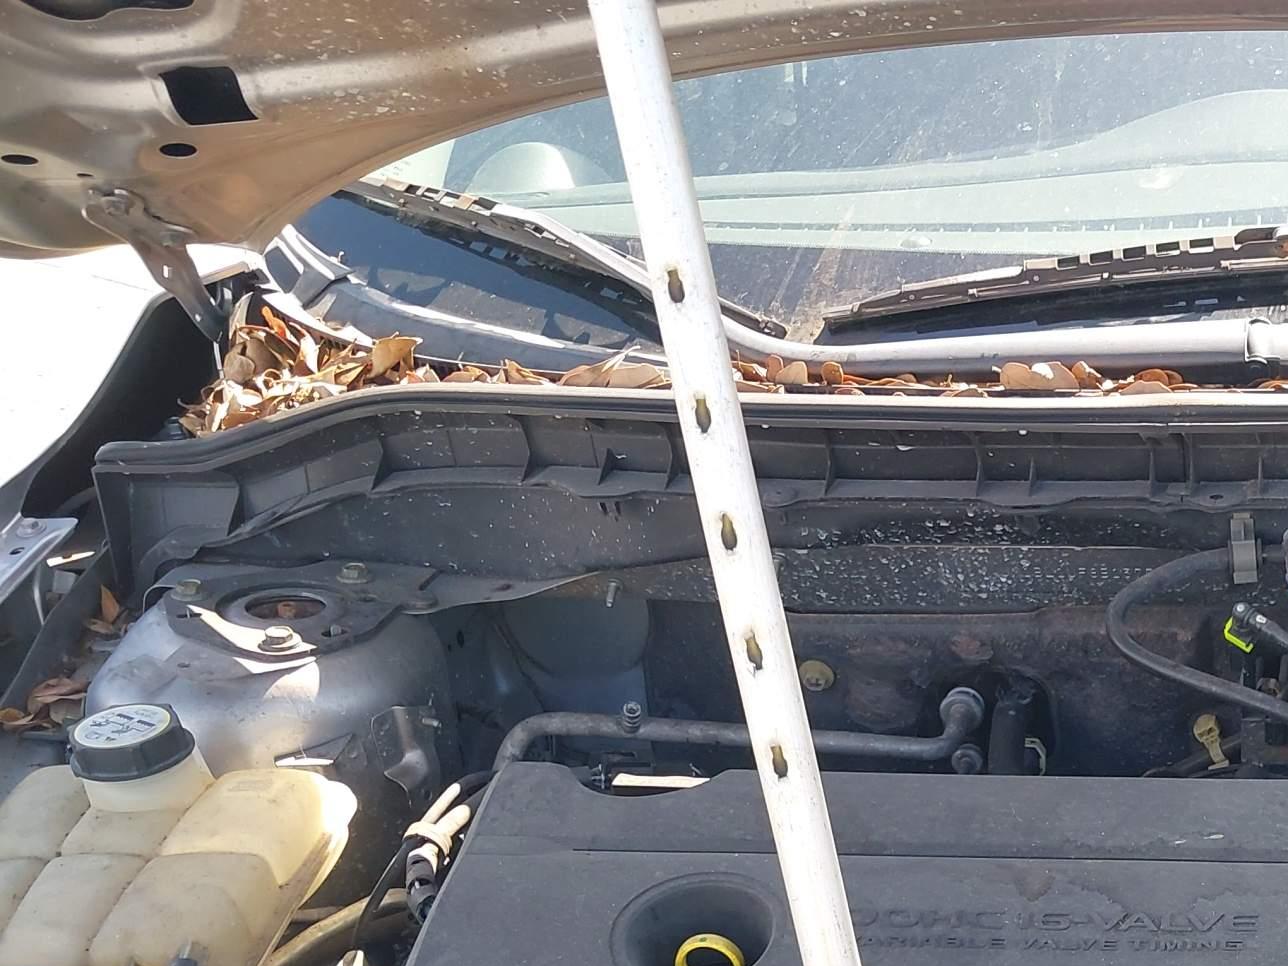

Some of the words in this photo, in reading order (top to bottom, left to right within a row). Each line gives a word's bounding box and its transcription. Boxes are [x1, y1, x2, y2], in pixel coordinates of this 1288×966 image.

[1015, 911, 1260, 933] 16-VALVE
[857, 936, 1007, 949] ARIABLE
[1023, 937, 1120, 952] VALVE
[1129, 938, 1247, 952] TIMING
